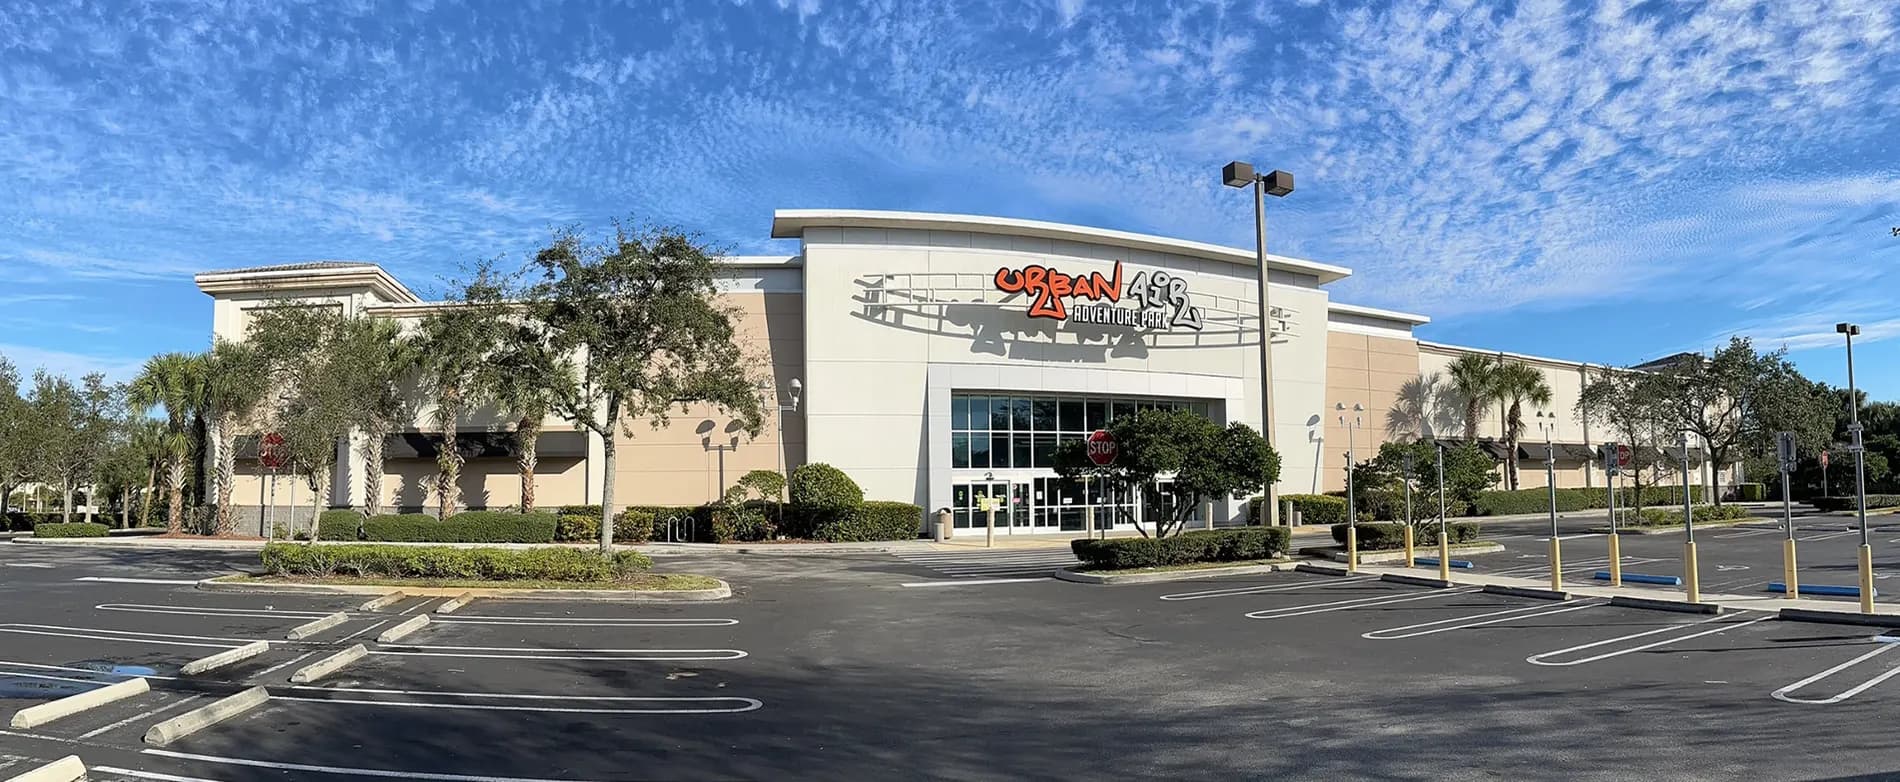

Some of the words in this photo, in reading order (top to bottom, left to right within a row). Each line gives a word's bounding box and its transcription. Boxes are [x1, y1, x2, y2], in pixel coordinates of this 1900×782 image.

[995, 260, 1122, 319] URBAN
[1073, 305, 1137, 326] ADVENTURE
[1141, 310, 1169, 330] PARK
[1090, 441, 1116, 455] STOP
